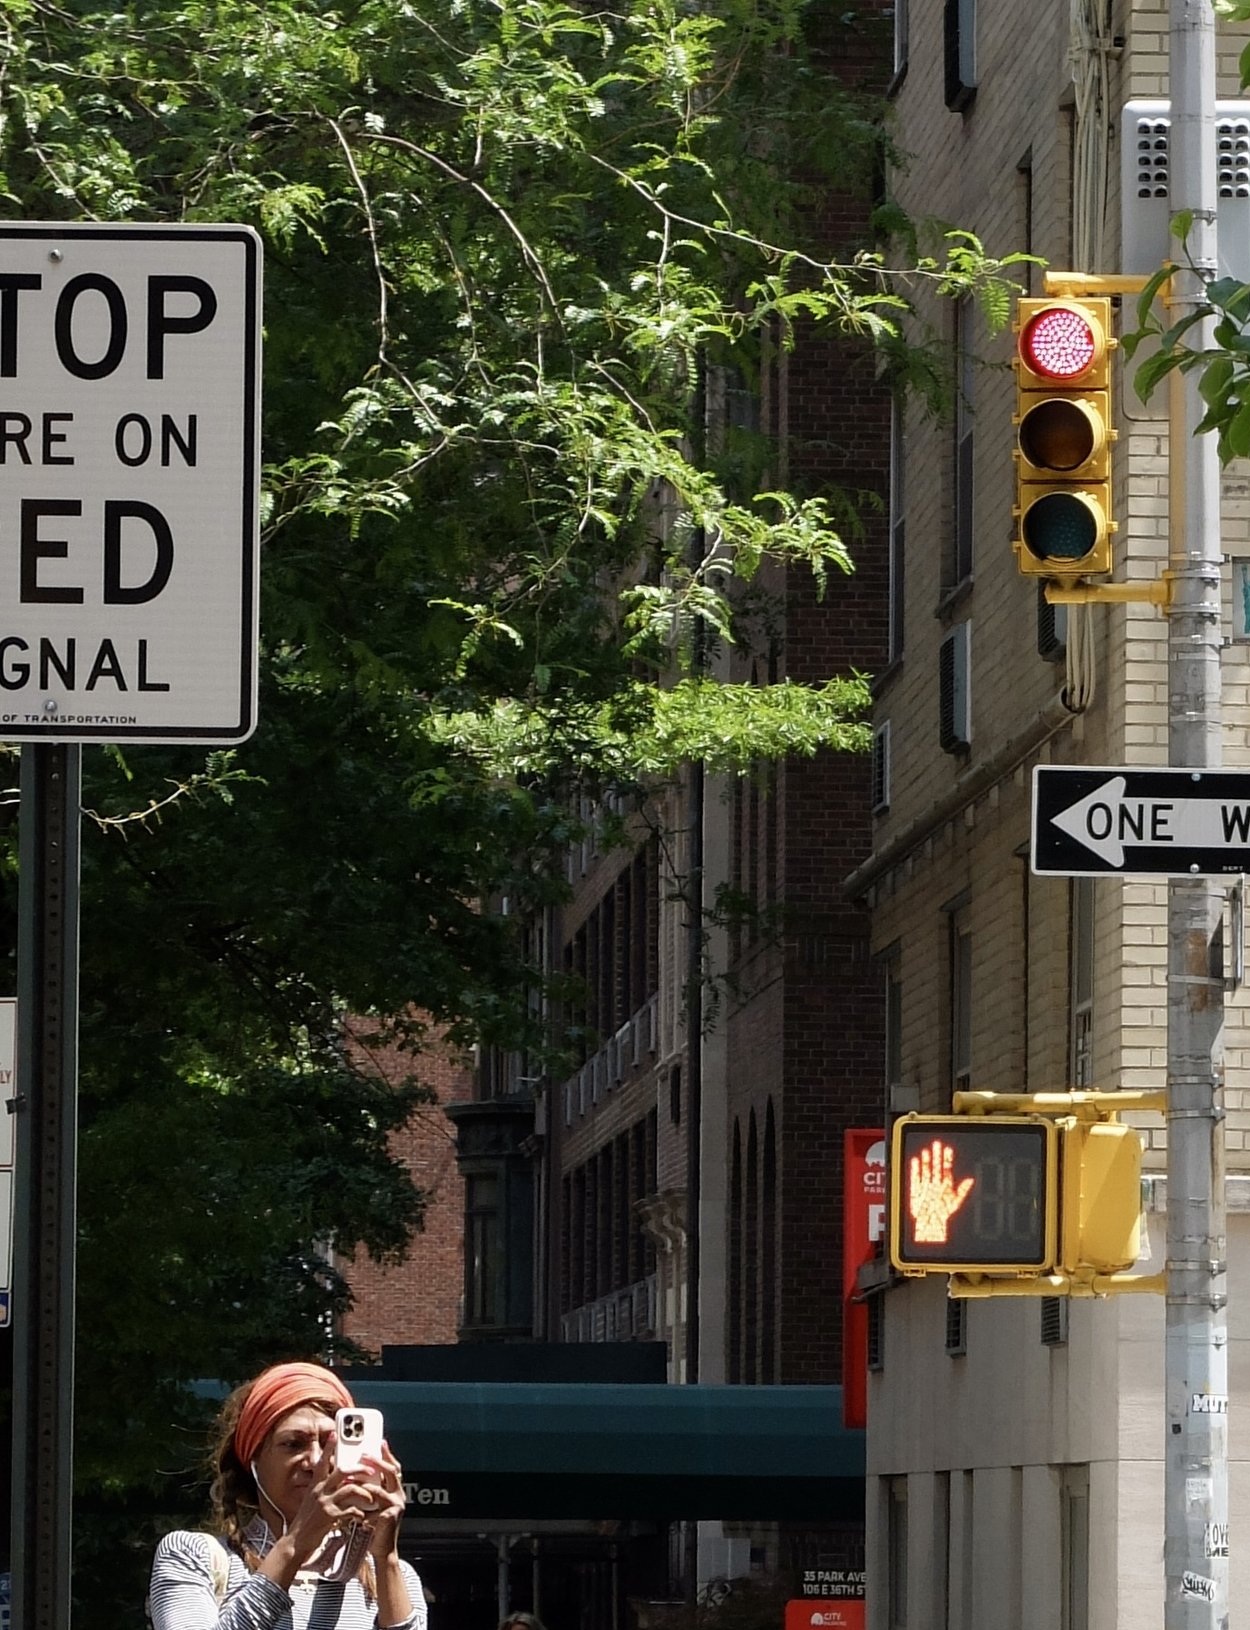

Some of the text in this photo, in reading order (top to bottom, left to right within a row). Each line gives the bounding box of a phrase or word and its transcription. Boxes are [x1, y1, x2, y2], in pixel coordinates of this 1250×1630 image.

[115, 413, 197, 467] ON
[2, 714, 137, 724] OF TRANSPORTATION
[1086, 803, 1175, 842] ONE
[403, 1483, 450, 1504] Ten
[804, 1571, 866, 1582] 35 PARK AVE
[822, 1585, 828, 1595] E
[824, 1612, 841, 1620] CITY
